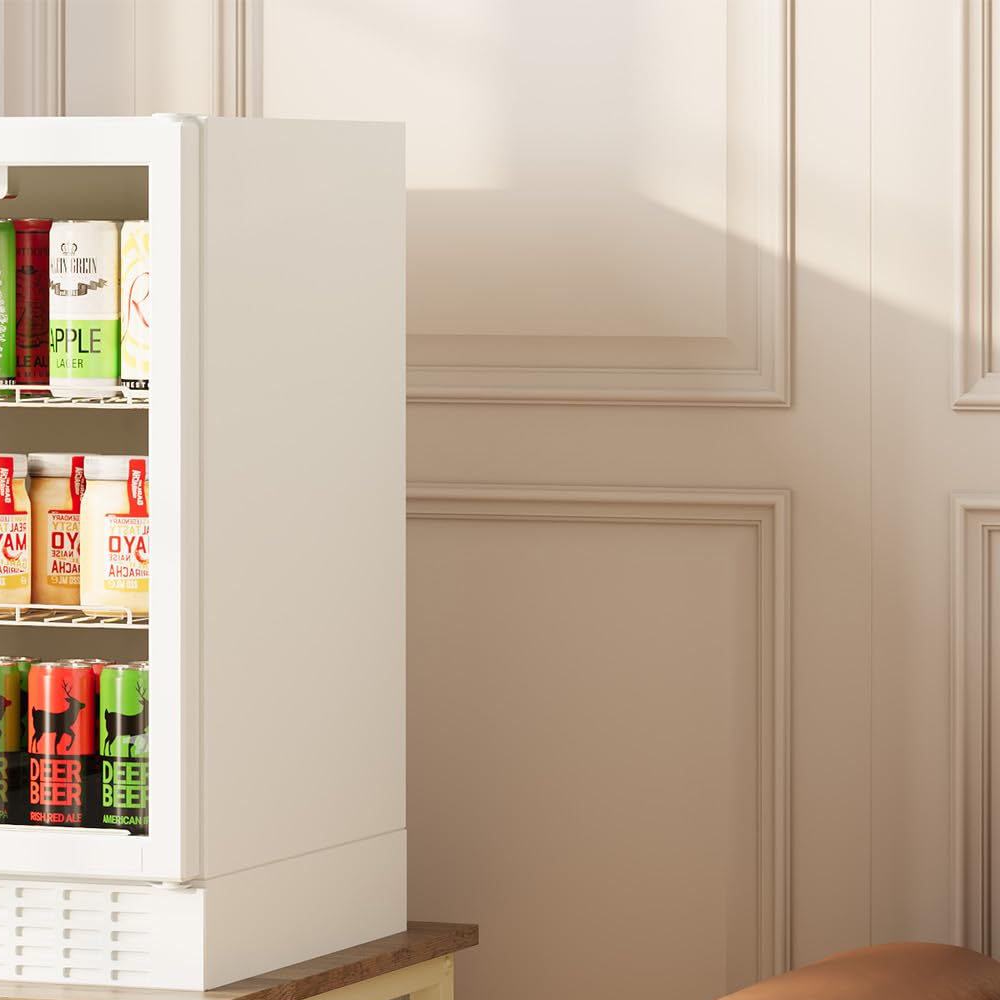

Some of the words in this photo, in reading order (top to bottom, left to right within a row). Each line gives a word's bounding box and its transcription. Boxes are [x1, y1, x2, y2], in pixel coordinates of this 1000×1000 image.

[56, 358, 84, 369] LAGER
[30, 757, 82, 783] DEER
[30, 781, 82, 806] BEER
